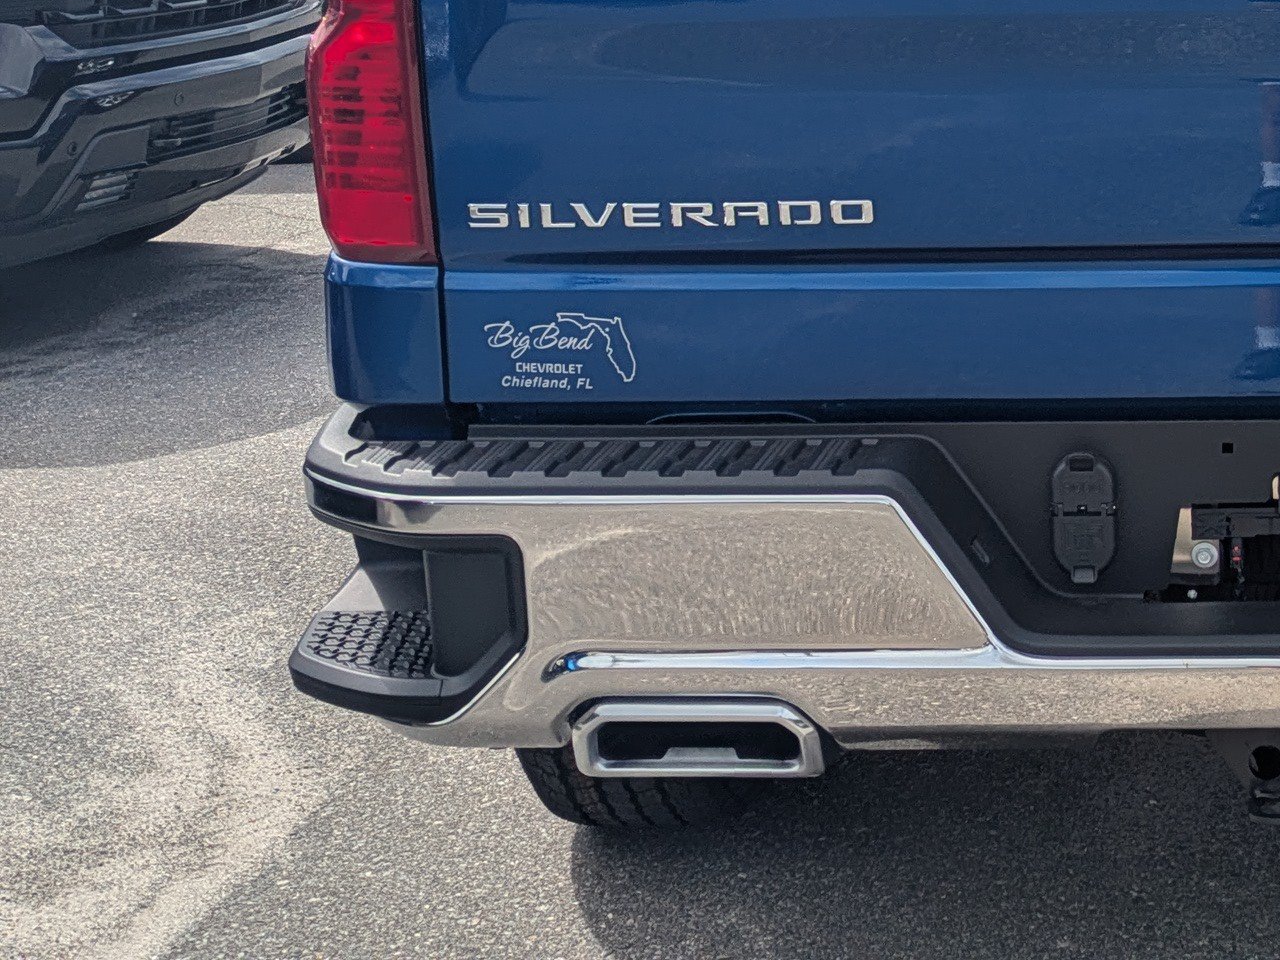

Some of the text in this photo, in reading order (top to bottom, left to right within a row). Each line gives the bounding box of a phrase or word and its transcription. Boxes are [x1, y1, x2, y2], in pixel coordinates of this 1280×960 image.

[467, 199, 875, 228] SILVERADO
[484, 320, 596, 359] Big Bend
[515, 362, 583, 374] CHEVROLET
[501, 375, 594, 390] Chiefland, FL
